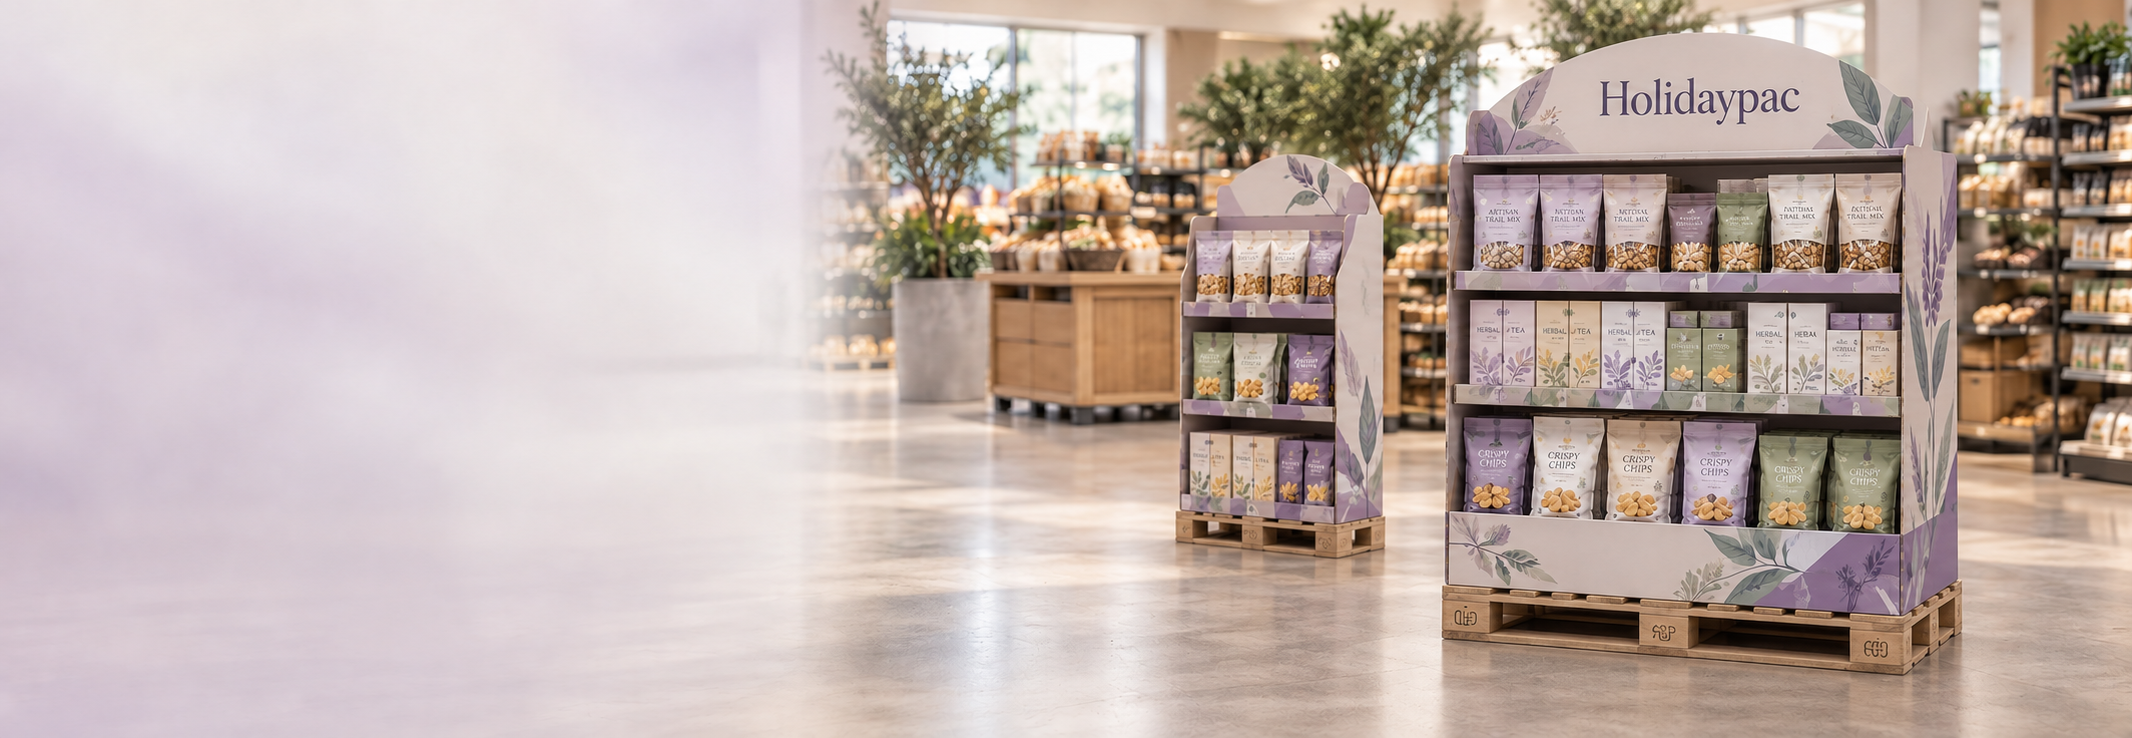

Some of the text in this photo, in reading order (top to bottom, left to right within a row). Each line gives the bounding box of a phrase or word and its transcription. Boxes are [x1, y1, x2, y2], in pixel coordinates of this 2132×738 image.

[1599, 77, 1800, 126] Holidaypac
[1488, 208, 1519, 216] ARTISAN
[1550, 215, 1586, 223] TRAIL MIX
[1547, 451, 1580, 460] CRISPY
[1622, 454, 1655, 464] CRISPY
[1479, 459, 1507, 468] CHIPS
[1548, 461, 1576, 470] CHIPS
[1699, 458, 1733, 467] CRISPY
[1623, 464, 1653, 473] CHIPS
[1700, 467, 1729, 477] CHIPS
[1775, 474, 1802, 484] CHIPS
[1849, 477, 1878, 486] CHIPS
